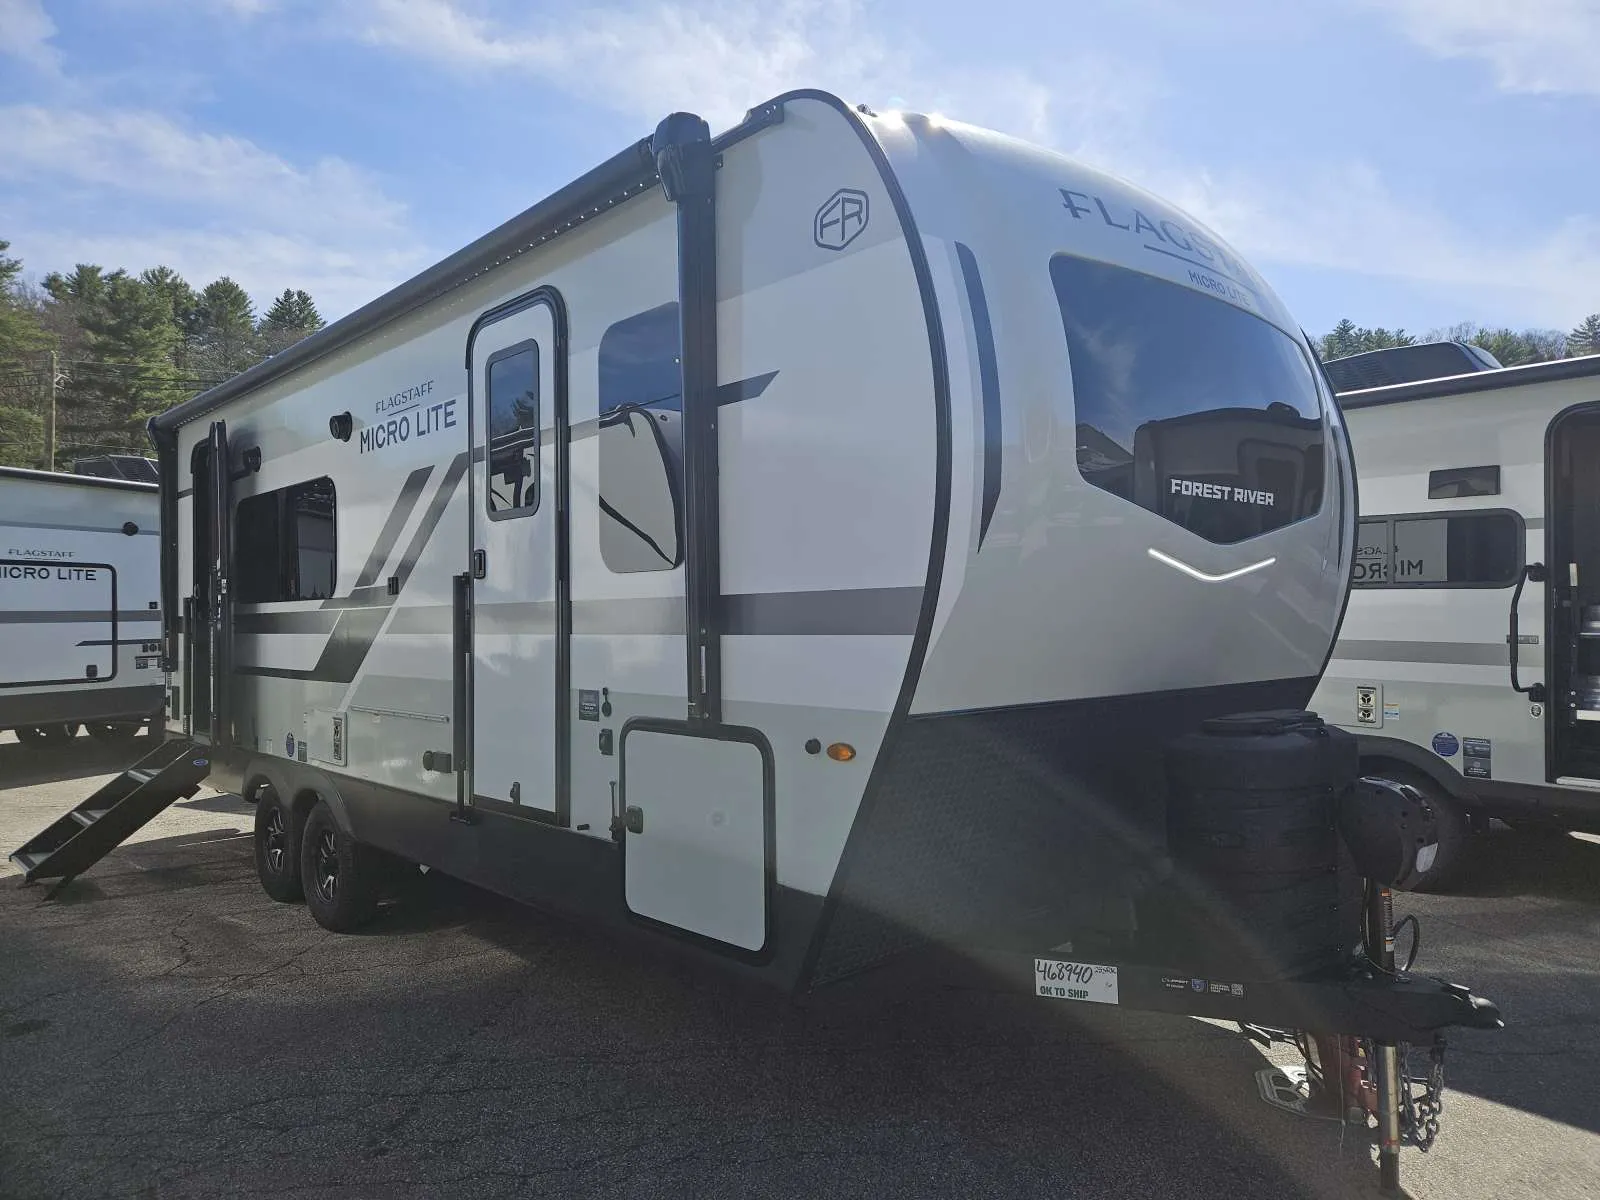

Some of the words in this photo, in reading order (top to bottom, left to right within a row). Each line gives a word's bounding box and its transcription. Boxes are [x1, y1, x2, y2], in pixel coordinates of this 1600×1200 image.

[1187, 269, 1227, 295] MICRO
[375, 380, 435, 414] FLAGSTAFF
[360, 416, 410, 454] MICRO
[416, 399, 457, 437] LITE
[1170, 479, 1231, 501] FOREST
[1233, 487, 1275, 506] RIVER
[8, 548, 76, 558] FLAGSTAFF
[0, 566, 50, 580] ICRO
[57, 569, 97, 581] LITE
[1036, 960, 1093, 984] 468940
[1040, 986, 1053, 995] OK
[1054, 987, 1066, 997] TO
[1067, 989, 1089, 999] SHIP
